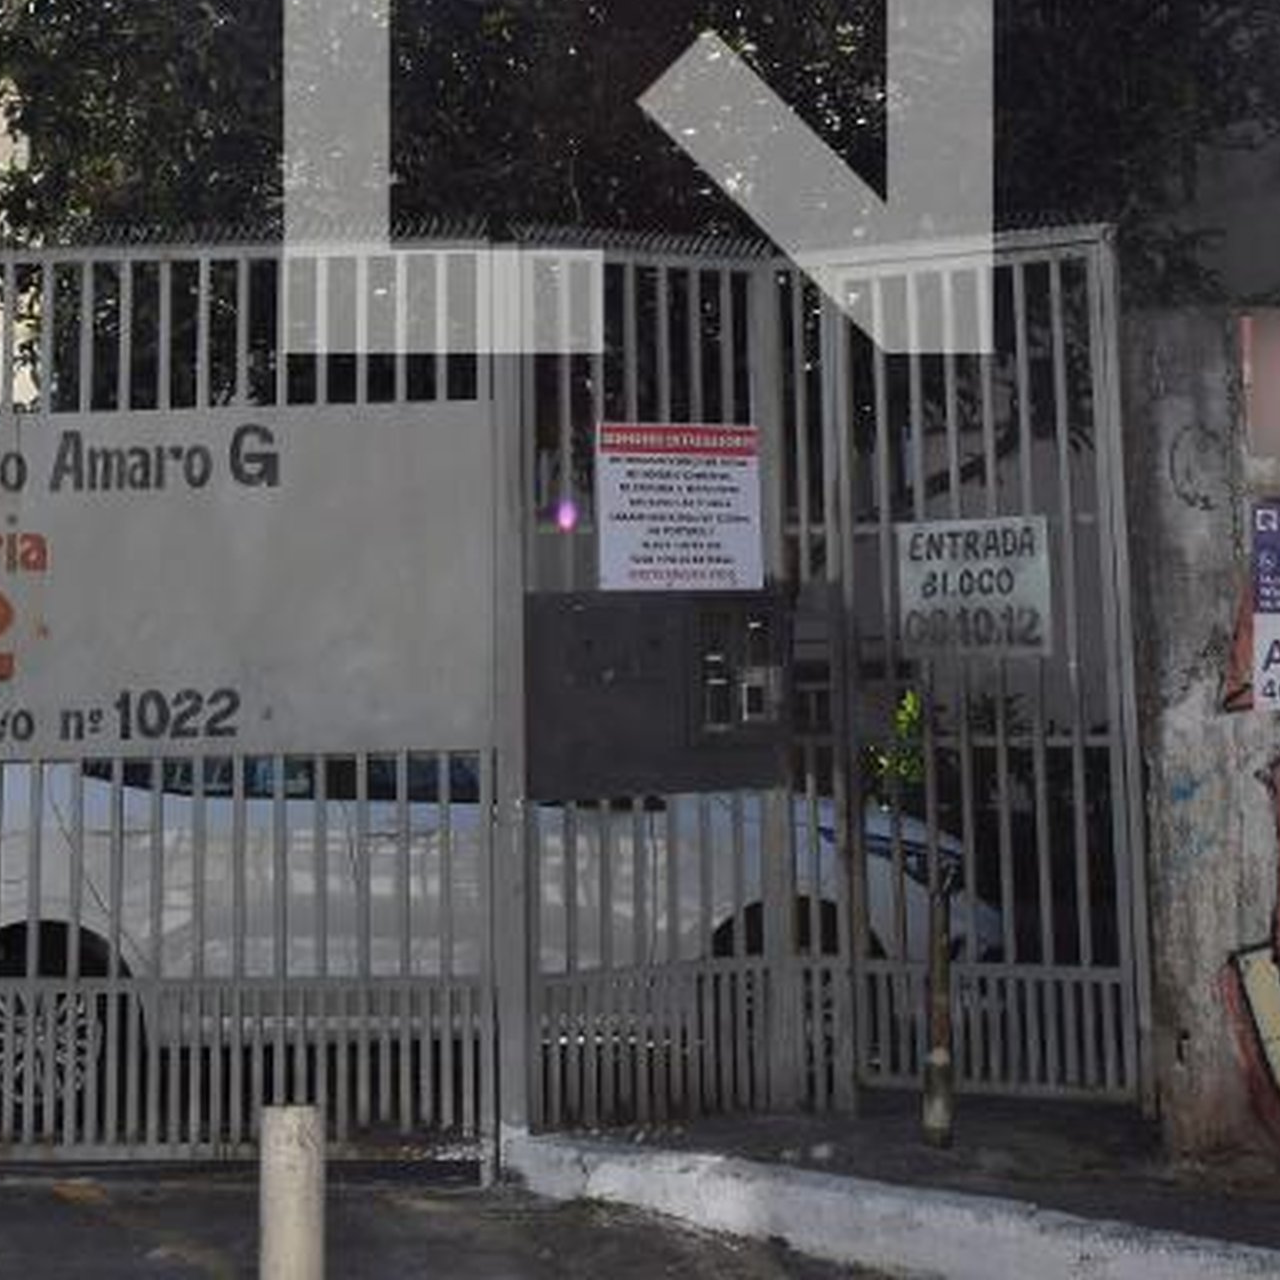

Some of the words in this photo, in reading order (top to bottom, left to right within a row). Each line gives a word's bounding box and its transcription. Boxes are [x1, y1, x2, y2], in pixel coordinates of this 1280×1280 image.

[49, 429, 213, 493] Amaro
[229, 423, 281, 488] G
[909, 526, 1035, 561] ENTRADA
[113, 688, 242, 741] 1022
